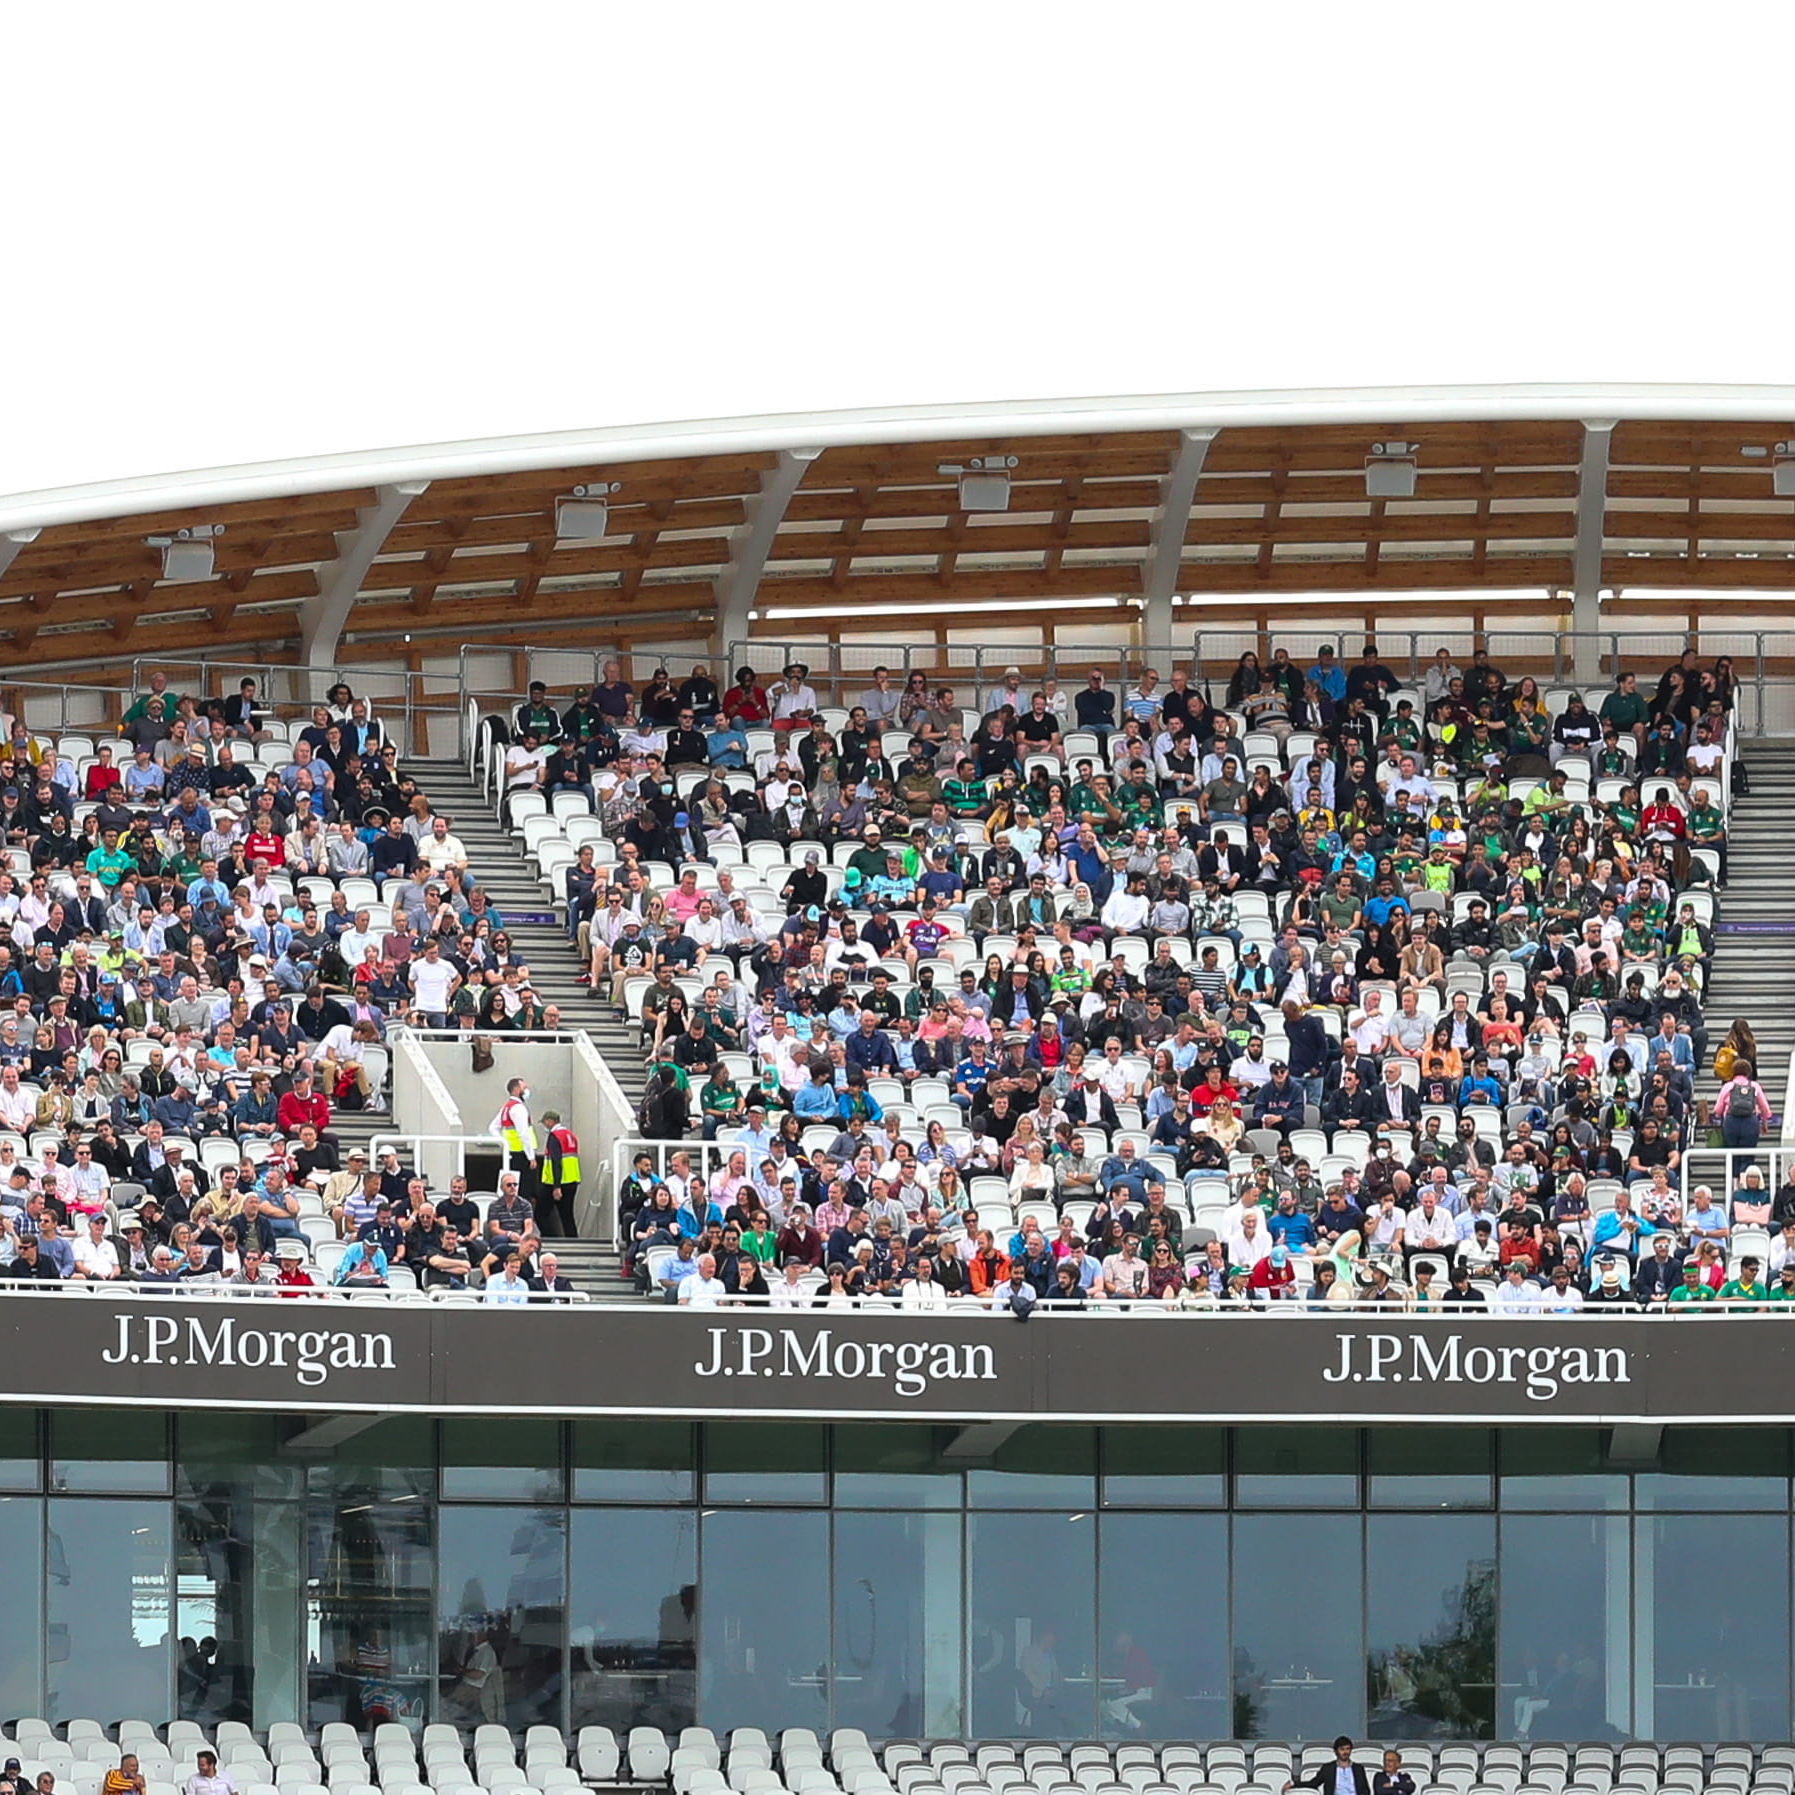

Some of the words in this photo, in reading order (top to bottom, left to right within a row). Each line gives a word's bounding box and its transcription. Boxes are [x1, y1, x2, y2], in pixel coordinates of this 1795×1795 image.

[103, 1315, 395, 1385] J.P.Morgan
[695, 1329, 997, 1395] J.P.Morgan
[1324, 1335, 1630, 1400] J.P.Morgan
